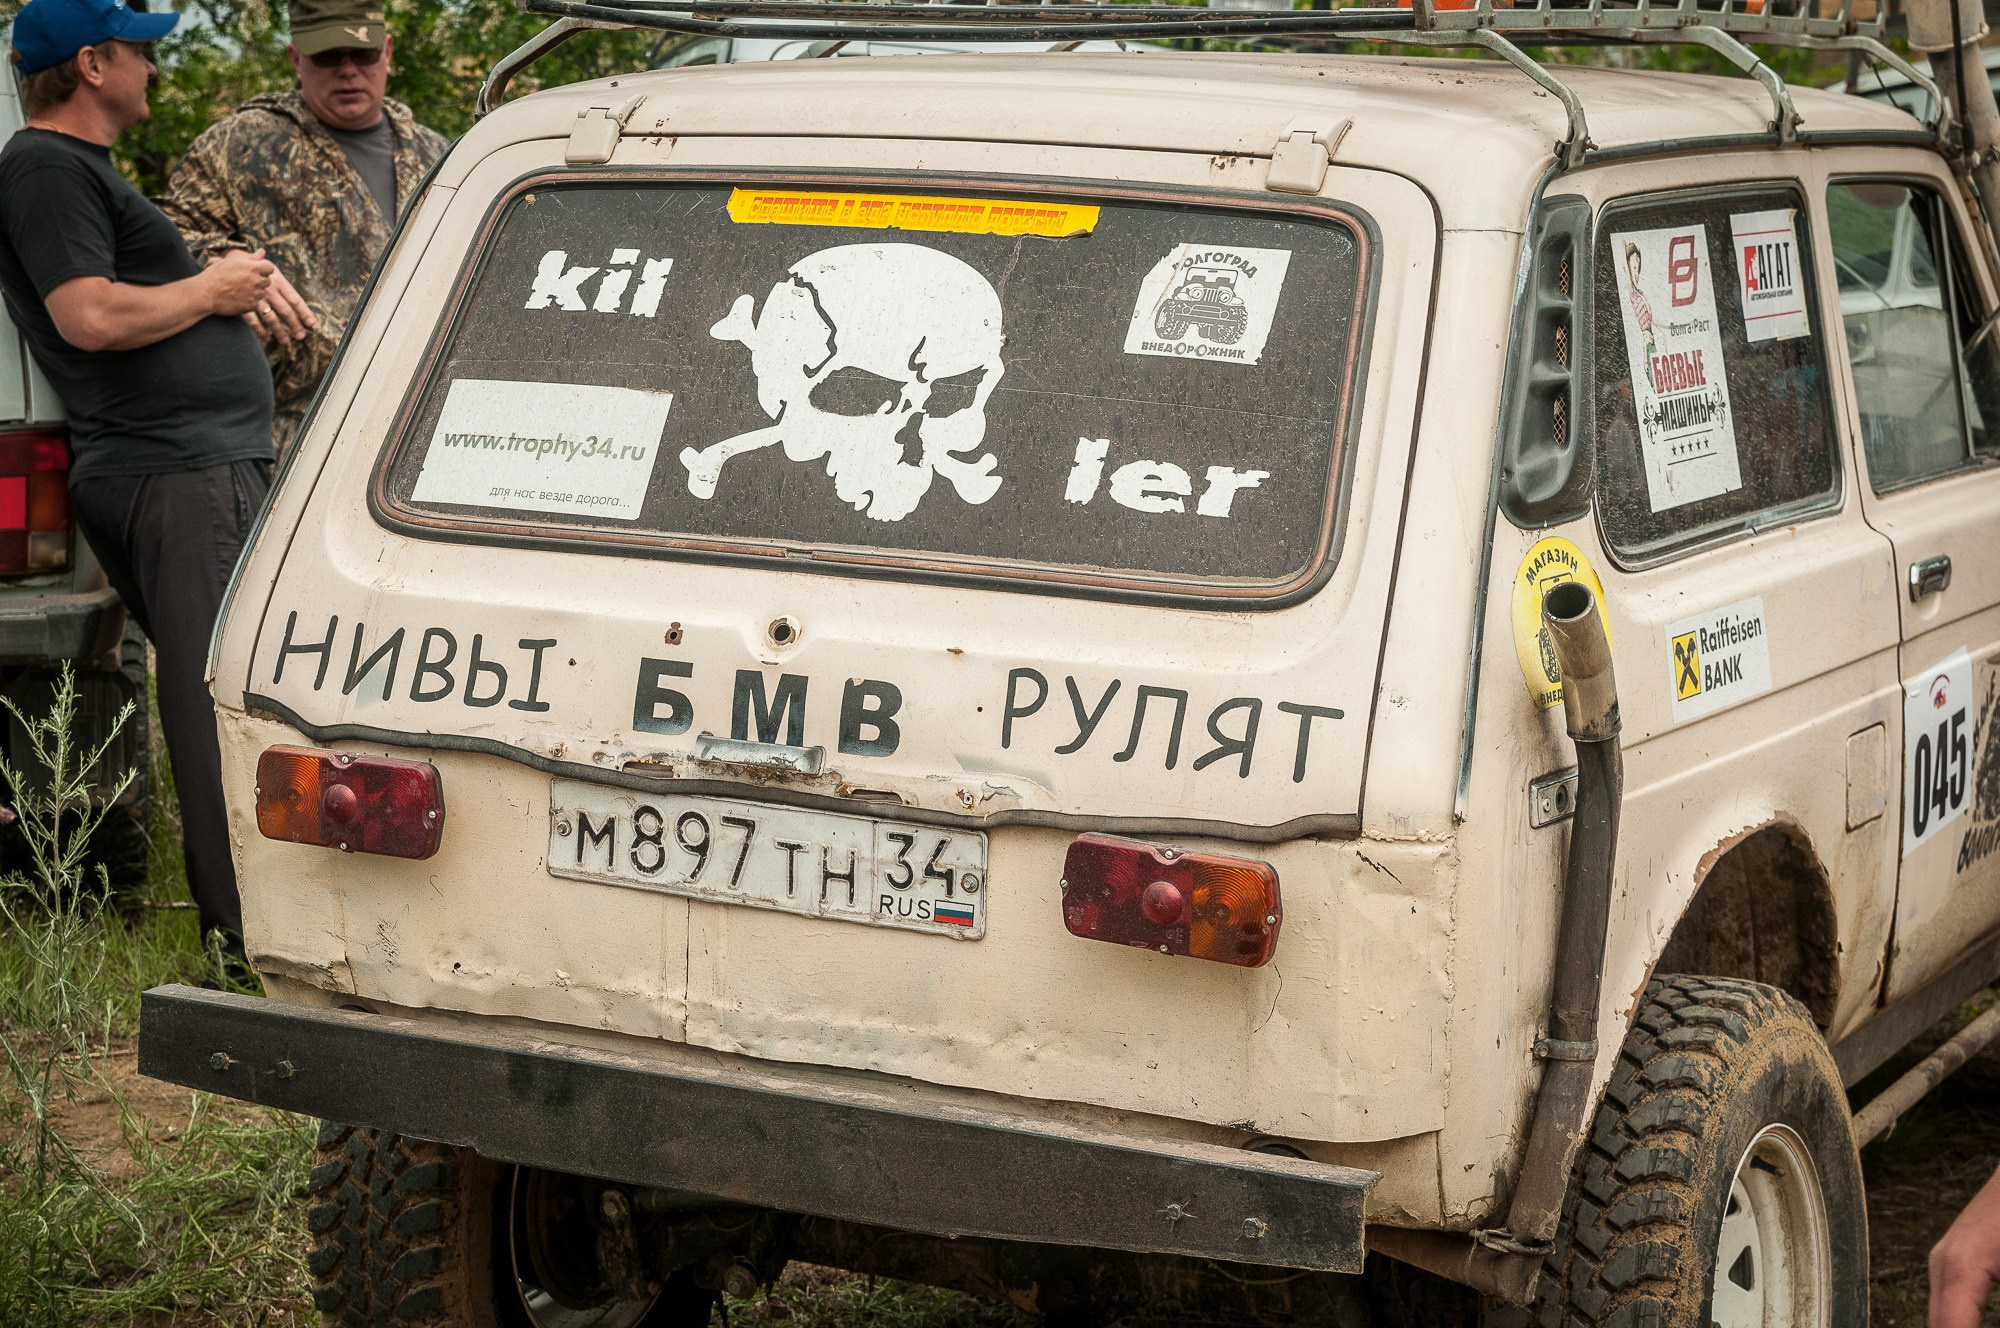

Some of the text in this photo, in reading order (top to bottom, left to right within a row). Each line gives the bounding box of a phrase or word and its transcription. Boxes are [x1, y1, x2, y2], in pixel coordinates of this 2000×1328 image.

[1141, 341, 1246, 359] ВНЕДОРОЖНИК
[1652, 349, 1706, 394] БОЕВЫЕ
[1659, 393, 1711, 432] МАШИНЫ
[444, 432, 646, 462] www.trophy34.ru
[489, 486, 630, 508] для нас везде дорога...
[1525, 548, 1579, 586] МАГАЗИН
[1700, 615, 1762, 655] Raiffeisen
[1705, 653, 1743, 693] BANK
[272, 610, 1345, 783] НИВЫ БМВ РУЛЯТ
[1913, 707, 1966, 838] 045
[884, 832, 955, 898] 34
[880, 894, 932, 920] RUS
